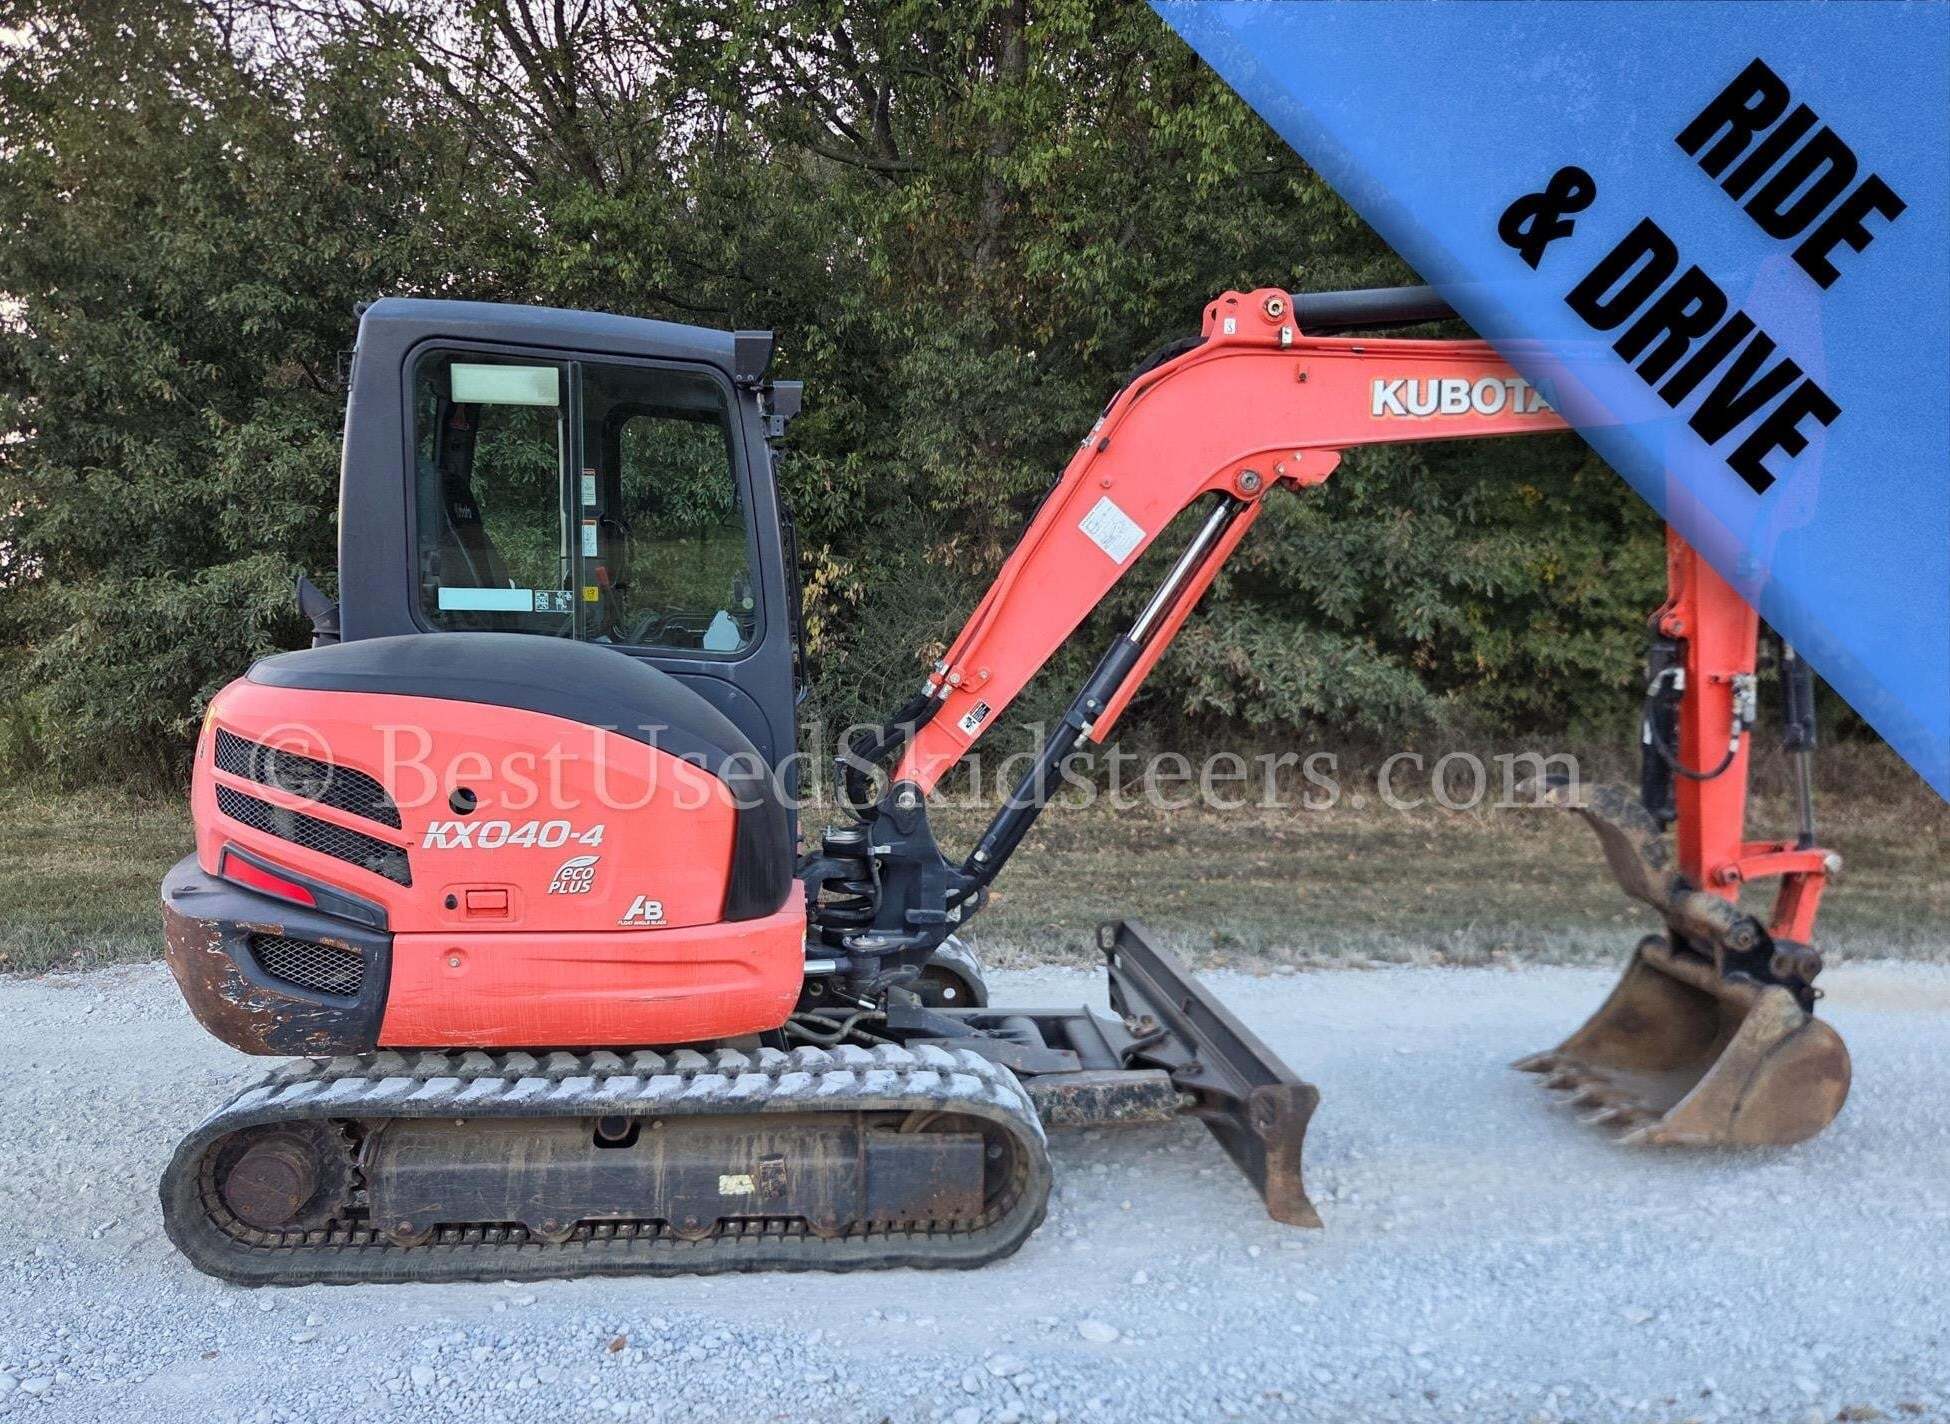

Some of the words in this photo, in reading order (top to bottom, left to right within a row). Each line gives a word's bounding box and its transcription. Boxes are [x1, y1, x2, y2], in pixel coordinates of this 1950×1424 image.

[422, 820, 605, 849] KX040-4
[560, 867, 595, 881] eco
[548, 880, 592, 894] PLUS
